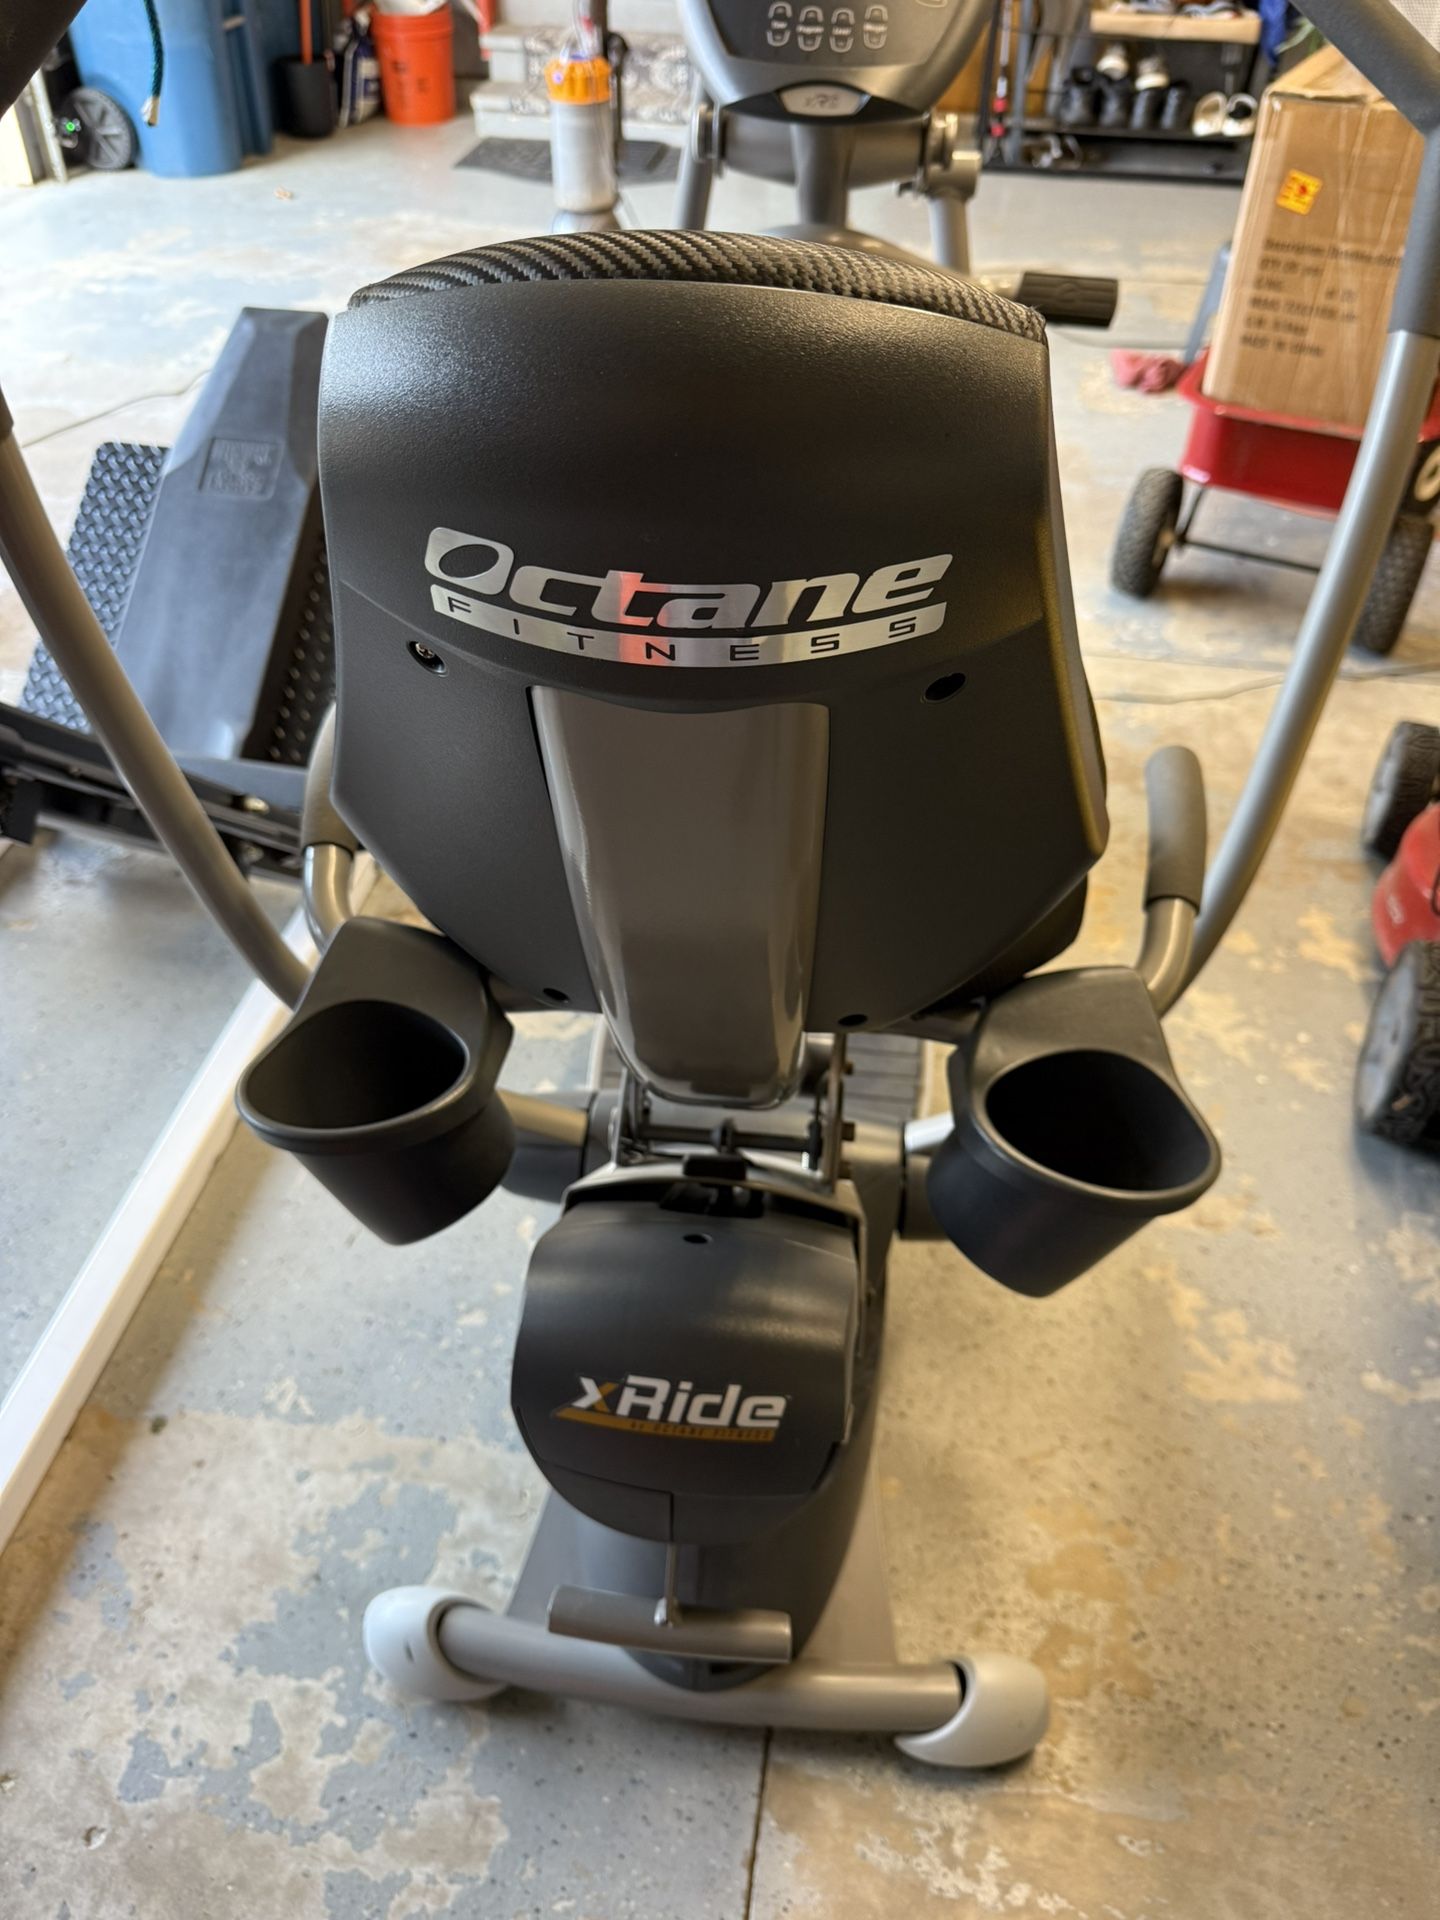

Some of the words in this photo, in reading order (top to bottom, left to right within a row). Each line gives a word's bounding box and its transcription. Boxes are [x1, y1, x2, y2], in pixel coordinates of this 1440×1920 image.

[425, 526, 953, 629] Octane
[447, 596, 917, 662] FITNESS
[571, 1374, 787, 1428] xRide
